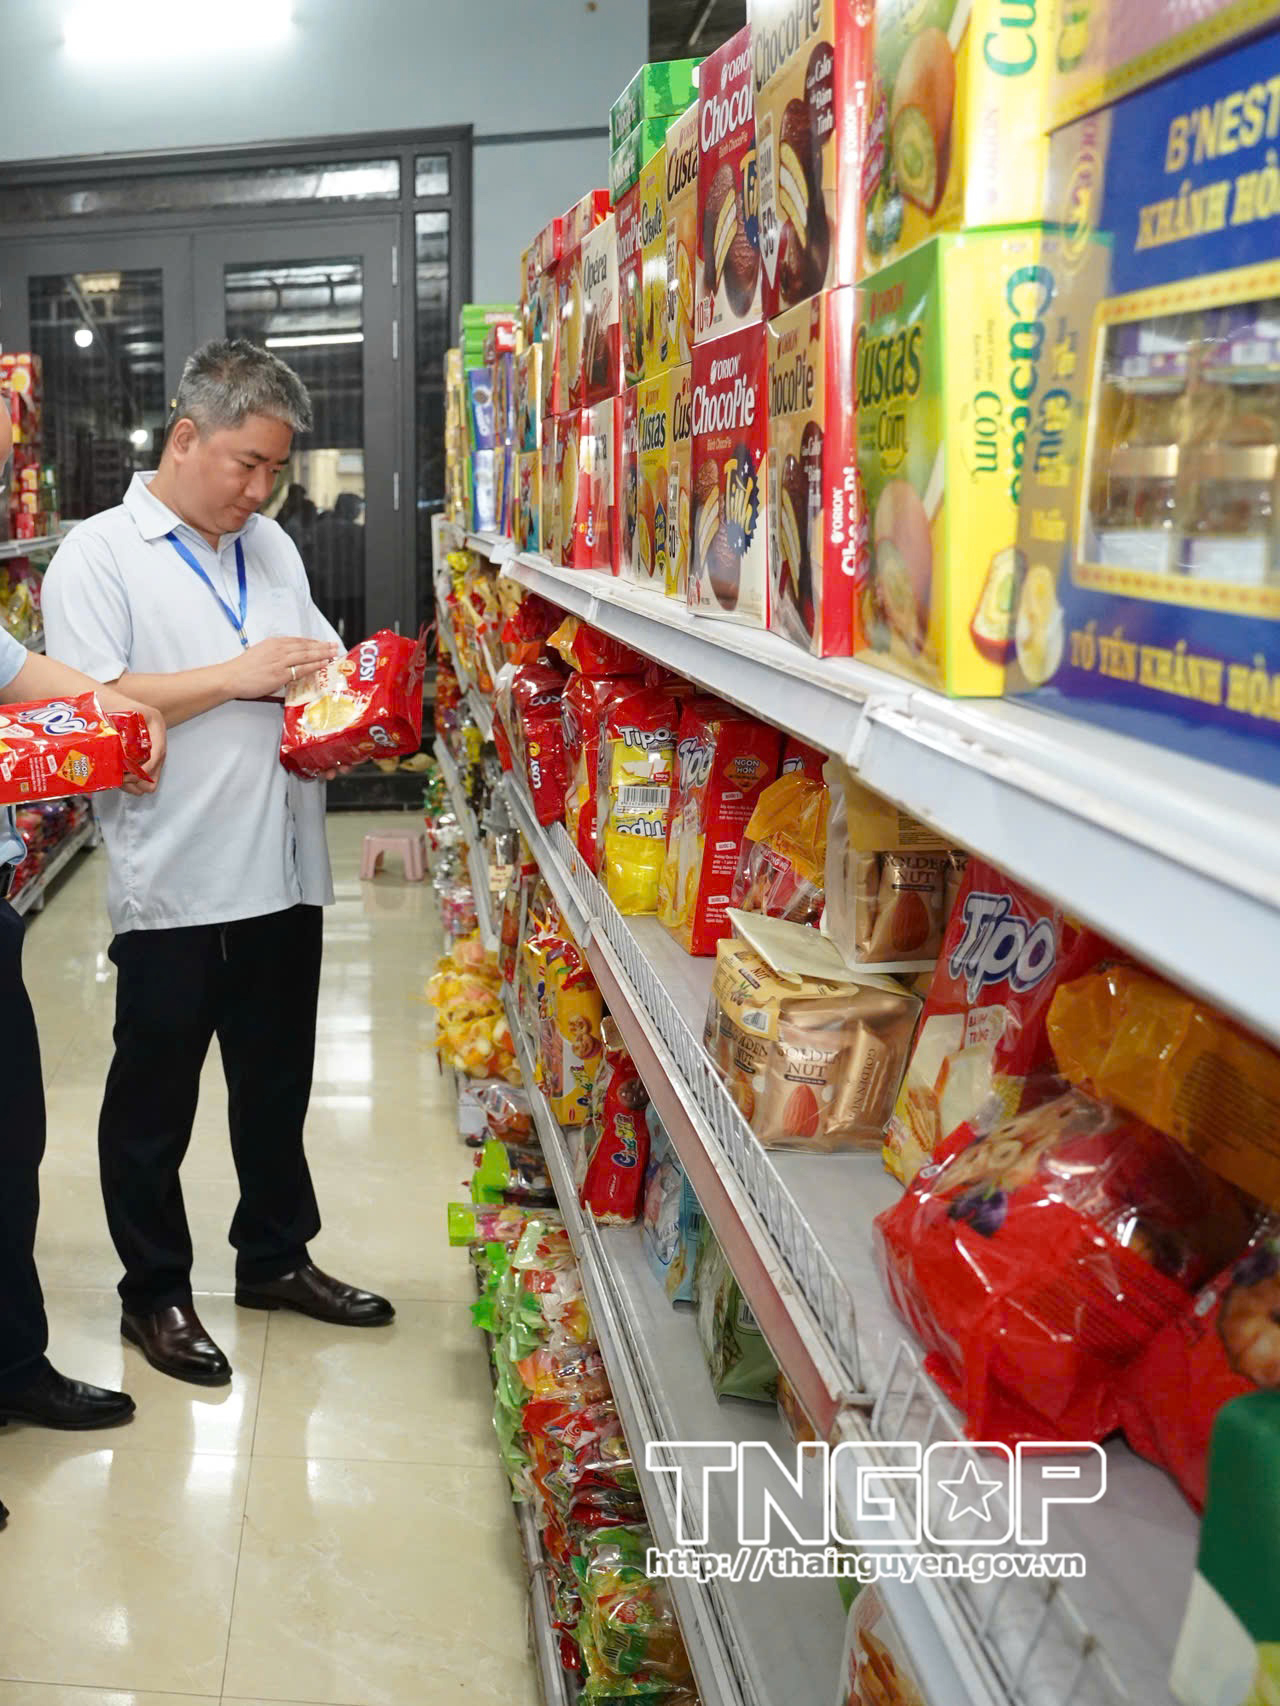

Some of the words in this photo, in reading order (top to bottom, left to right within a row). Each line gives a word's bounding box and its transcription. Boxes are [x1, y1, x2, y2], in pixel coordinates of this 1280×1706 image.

[716, 355, 740, 381] ORION
[673, 391, 692, 443] Cus
[692, 373, 756, 437] ChocoPie
[359, 644, 379, 682] COSY
[619, 726, 671, 750] Tipo
[529, 757, 542, 789] COSY
[734, 759, 760, 767] NGON
[949, 891, 1057, 1004] Tipo
[786, 1062, 828, 1076] NUT
